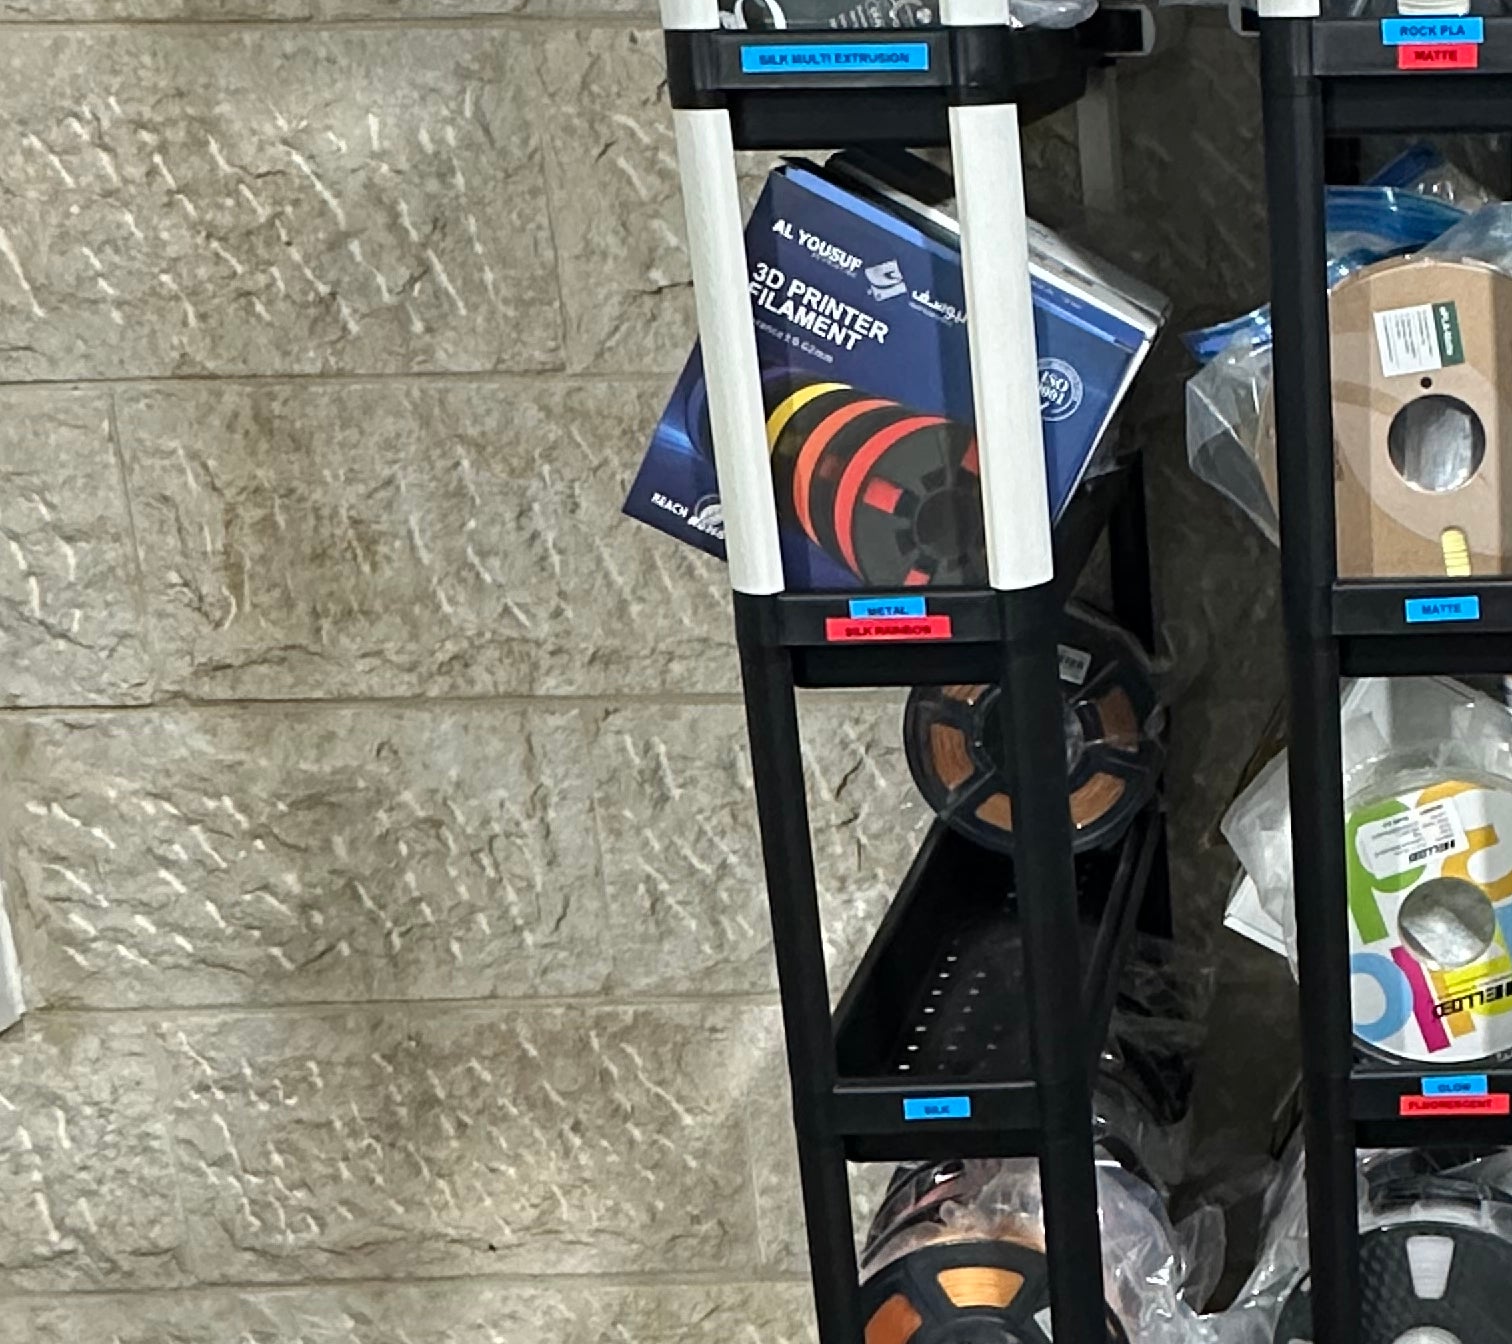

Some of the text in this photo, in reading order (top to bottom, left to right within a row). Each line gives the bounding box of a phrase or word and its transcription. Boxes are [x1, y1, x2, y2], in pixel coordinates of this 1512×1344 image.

[1400, 24, 1466, 36] ROCK PLA
[792, 53, 831, 65] MULTI
[835, 52, 910, 64] EXTRUSION
[1414, 49, 1457, 61] MATTE
[772, 218, 795, 240] AL
[797, 228, 864, 273] YOUSUF
[752, 262, 786, 291] 3D
[786, 278, 890, 345] PRINTER
[749, 280, 863, 352] FILAMENT
[1421, 603, 1462, 615] MATTE
